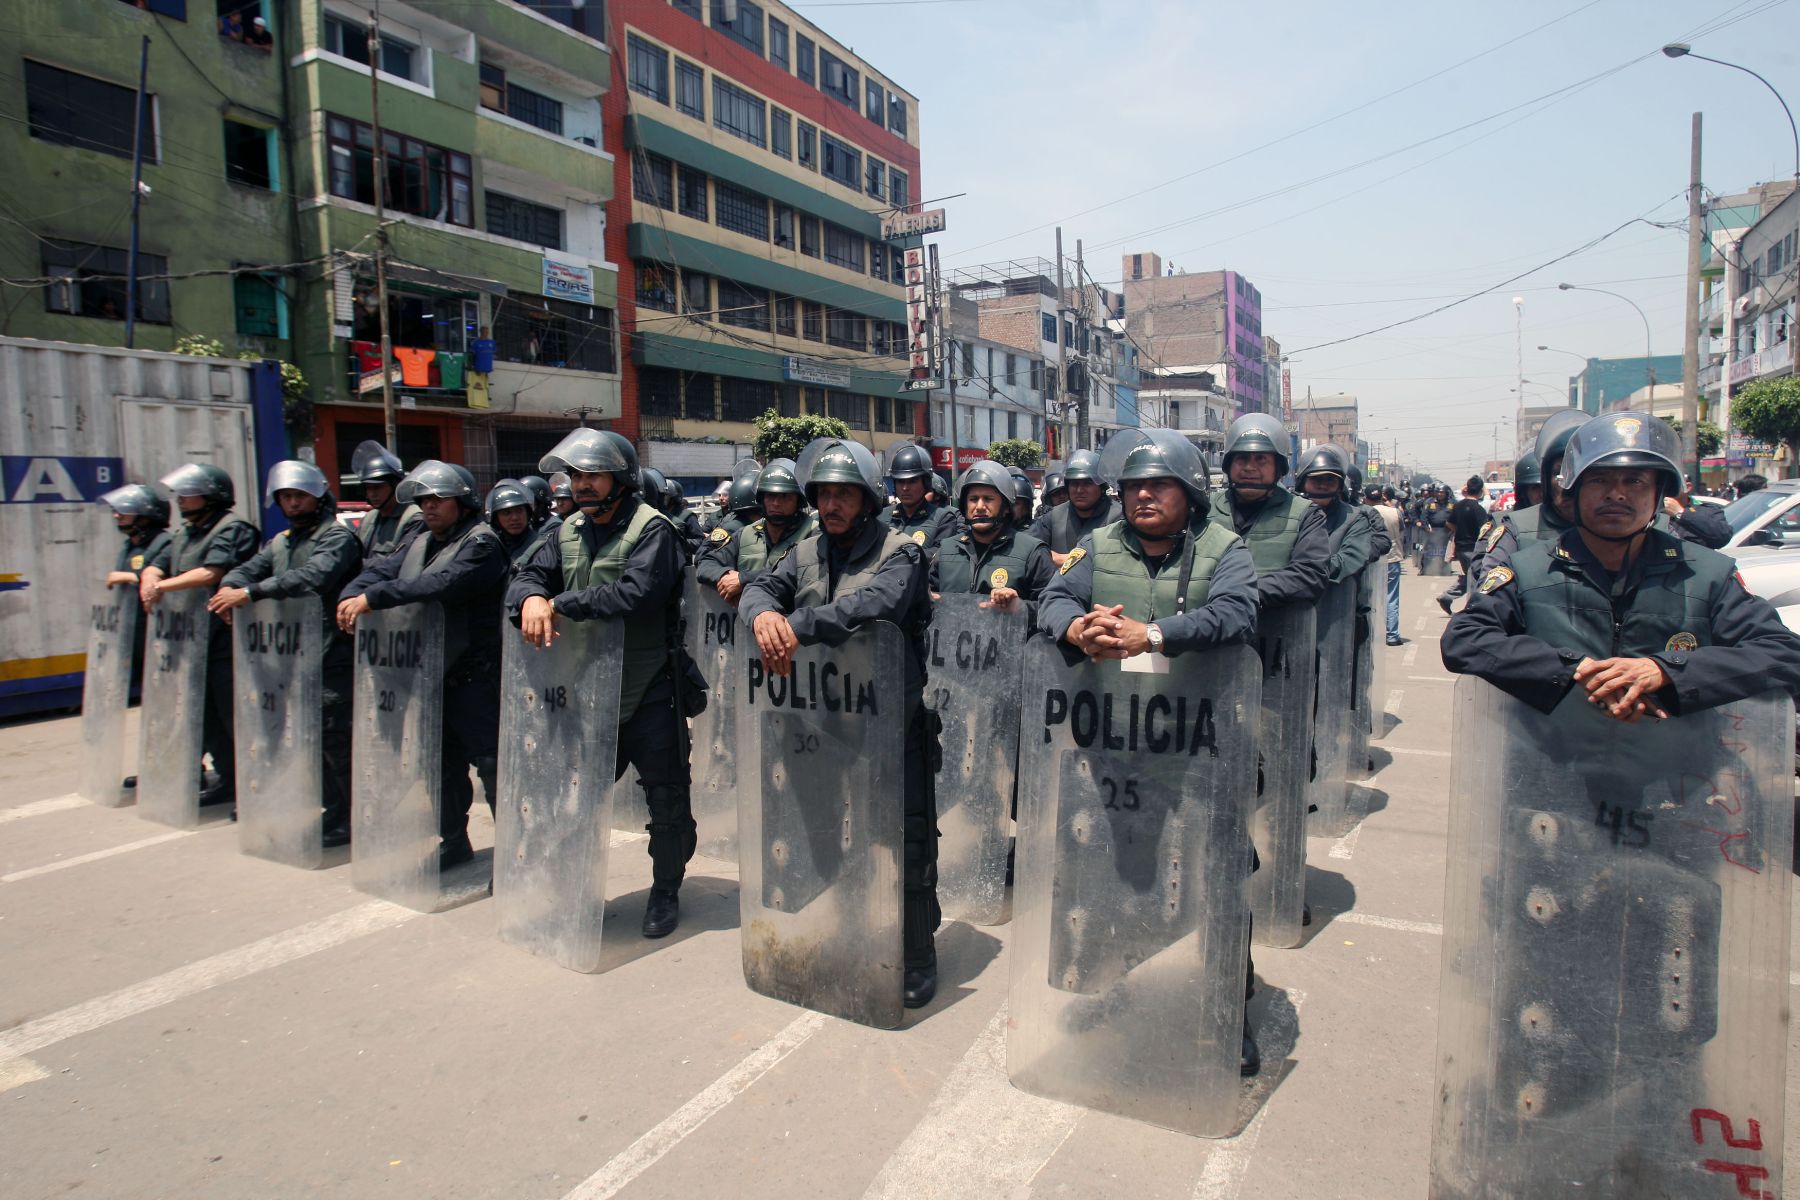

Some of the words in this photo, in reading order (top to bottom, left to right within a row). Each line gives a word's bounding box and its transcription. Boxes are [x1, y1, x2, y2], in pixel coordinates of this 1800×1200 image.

[912, 380, 936, 389] 636
[97, 466, 111, 483] B
[1045, 688, 1219, 758] POLICIA
[1102, 777, 1140, 811] 25
[1595, 803, 1654, 849] 45
